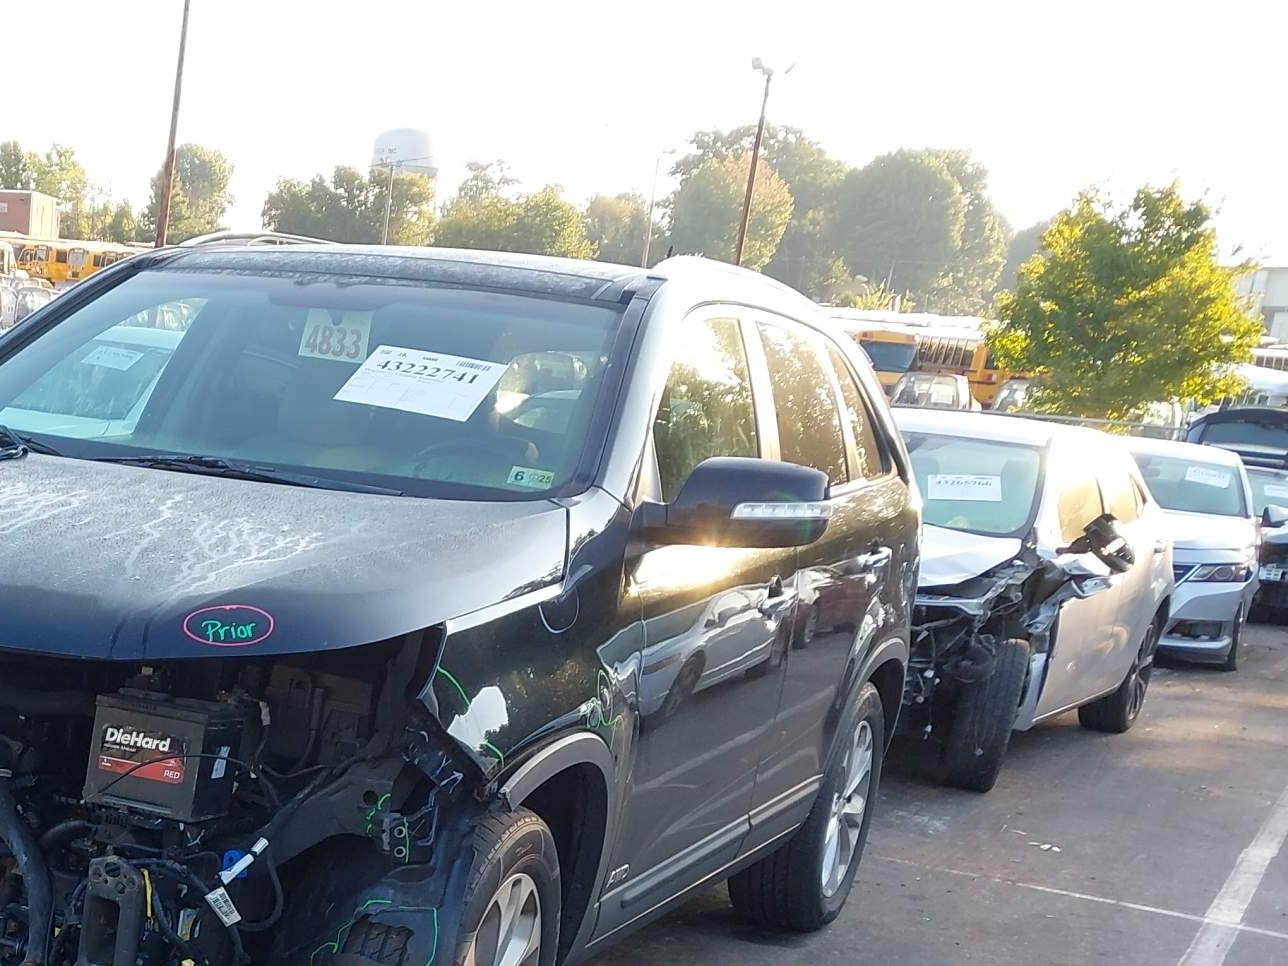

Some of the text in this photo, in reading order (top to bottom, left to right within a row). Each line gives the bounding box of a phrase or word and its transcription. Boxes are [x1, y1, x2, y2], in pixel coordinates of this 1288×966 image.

[304, 325, 362, 359] 4833
[376, 359, 480, 384] 43222741
[514, 470, 525, 481] 6
[201, 620, 256, 642] Prior
[105, 727, 172, 752] DieHard
[163, 769, 181, 779] RED
